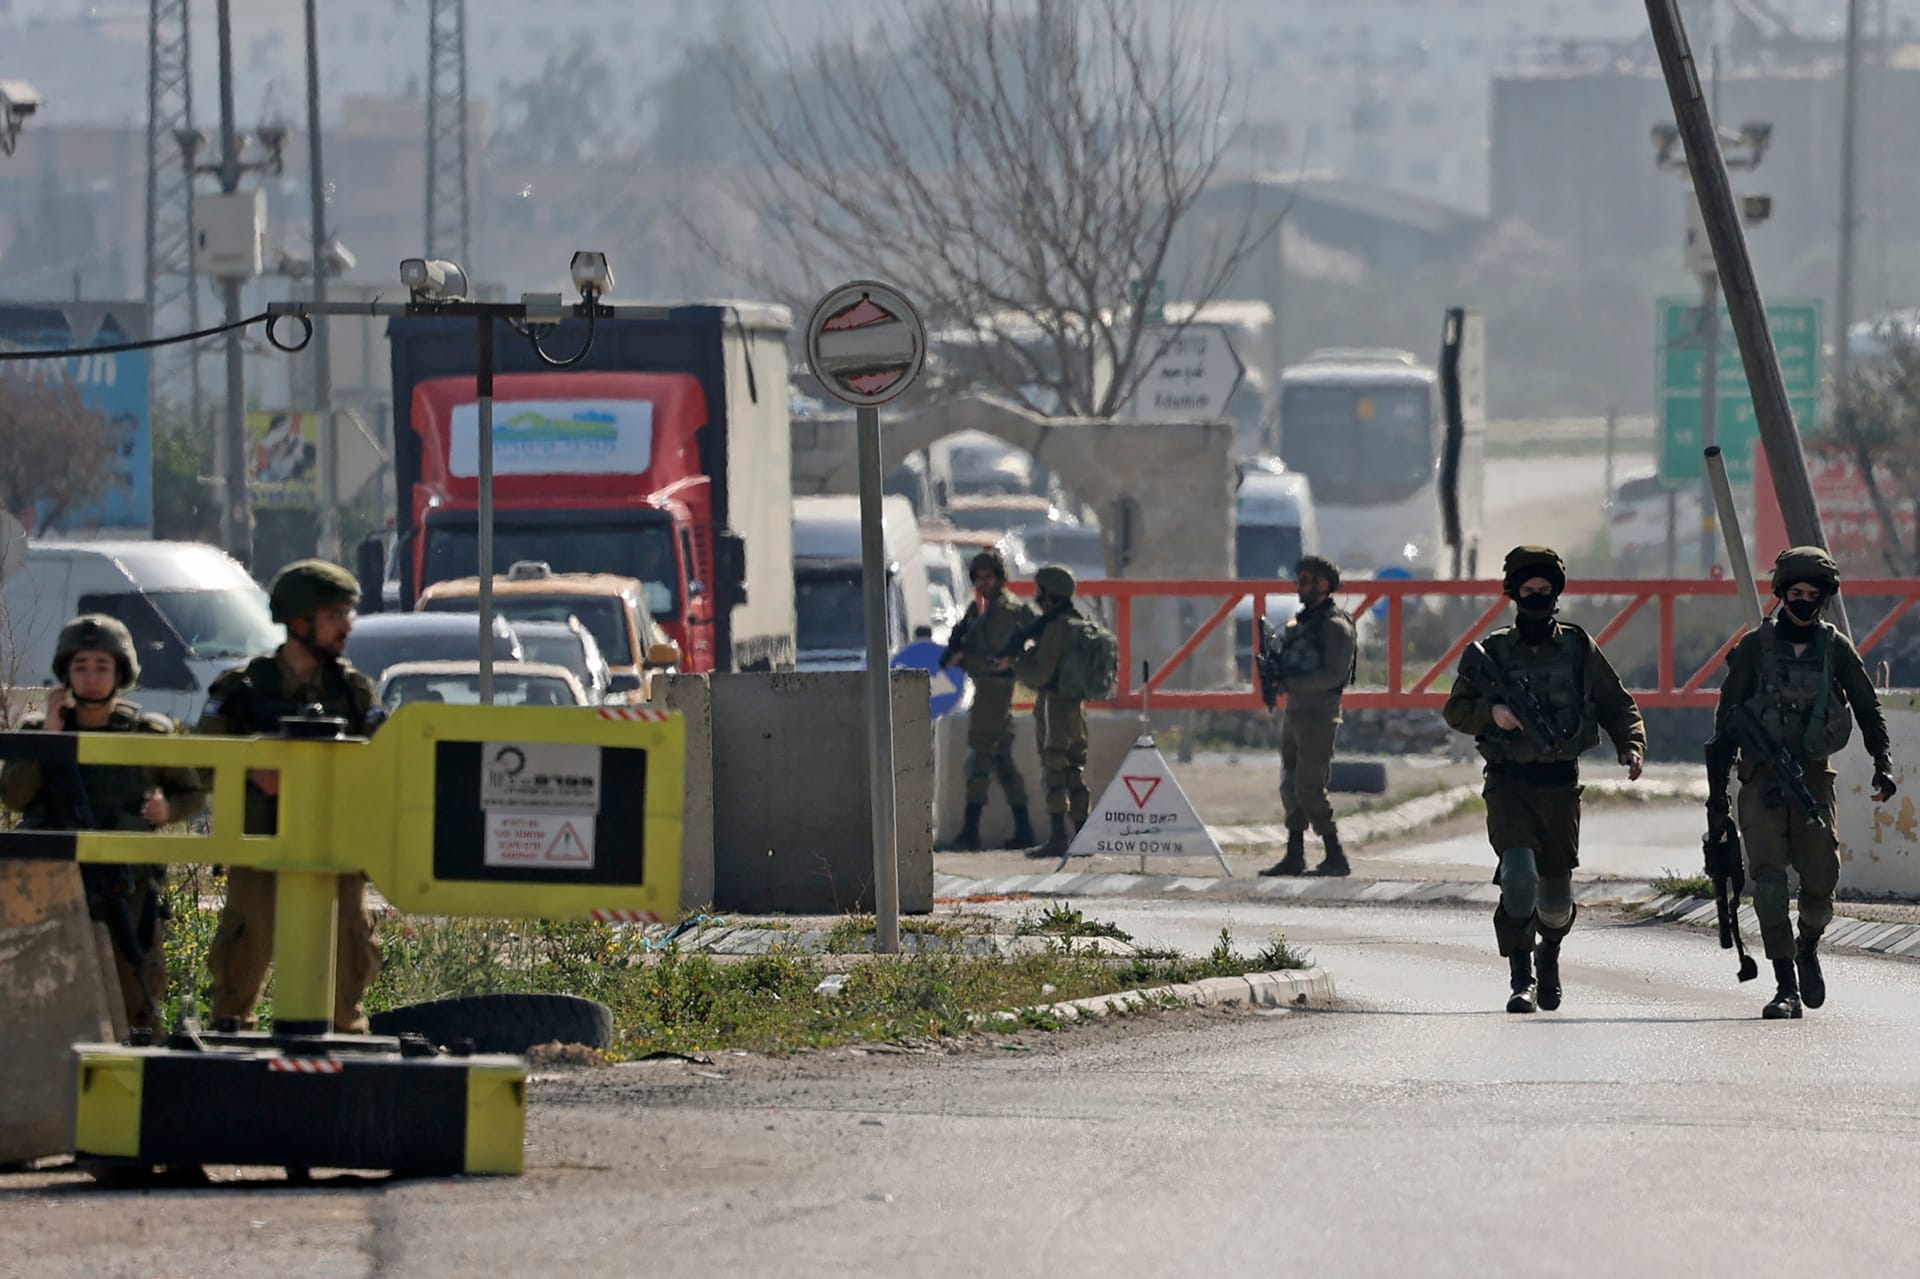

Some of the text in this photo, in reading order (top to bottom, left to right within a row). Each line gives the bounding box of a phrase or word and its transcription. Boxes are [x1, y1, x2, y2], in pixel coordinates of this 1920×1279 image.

[1105, 811, 1144, 824] מחסום
[1097, 840, 1184, 853] SLOW DOWN
